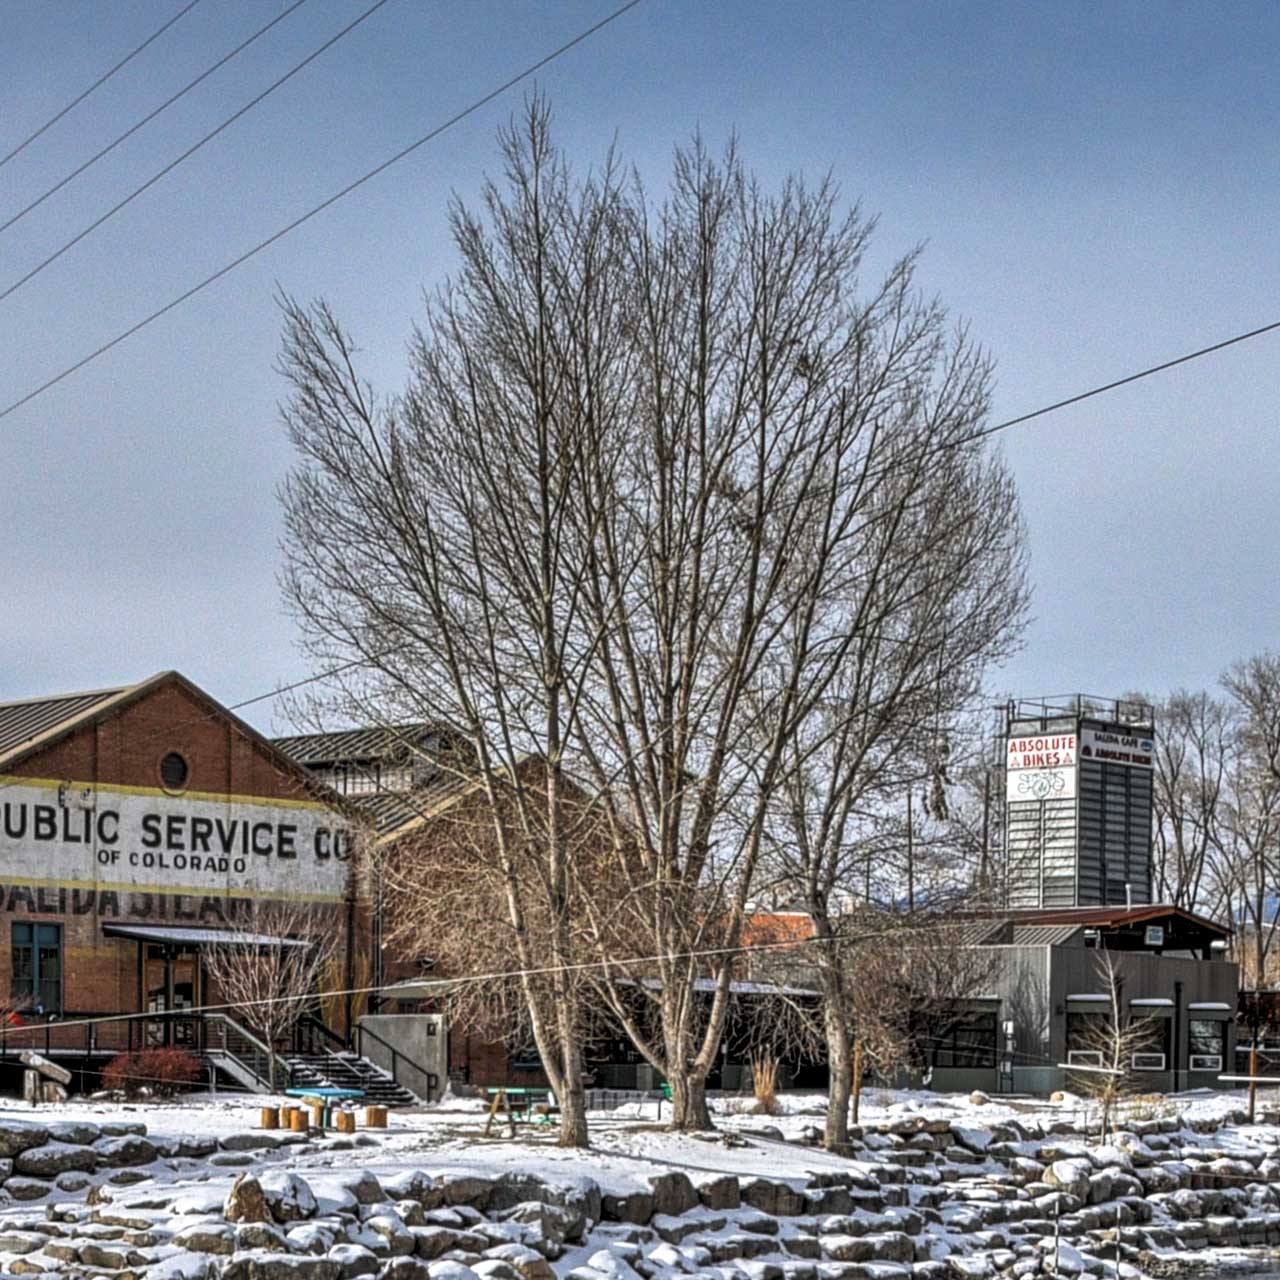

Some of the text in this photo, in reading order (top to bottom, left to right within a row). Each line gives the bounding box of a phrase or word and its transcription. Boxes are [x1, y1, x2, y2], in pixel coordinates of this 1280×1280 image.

[1009, 737, 1075, 753] ABSOLUTE
[1023, 752, 1060, 767] BIKES
[141, 814, 297, 859] SERVICE
[97, 850, 246, 873] OF COLORADO
